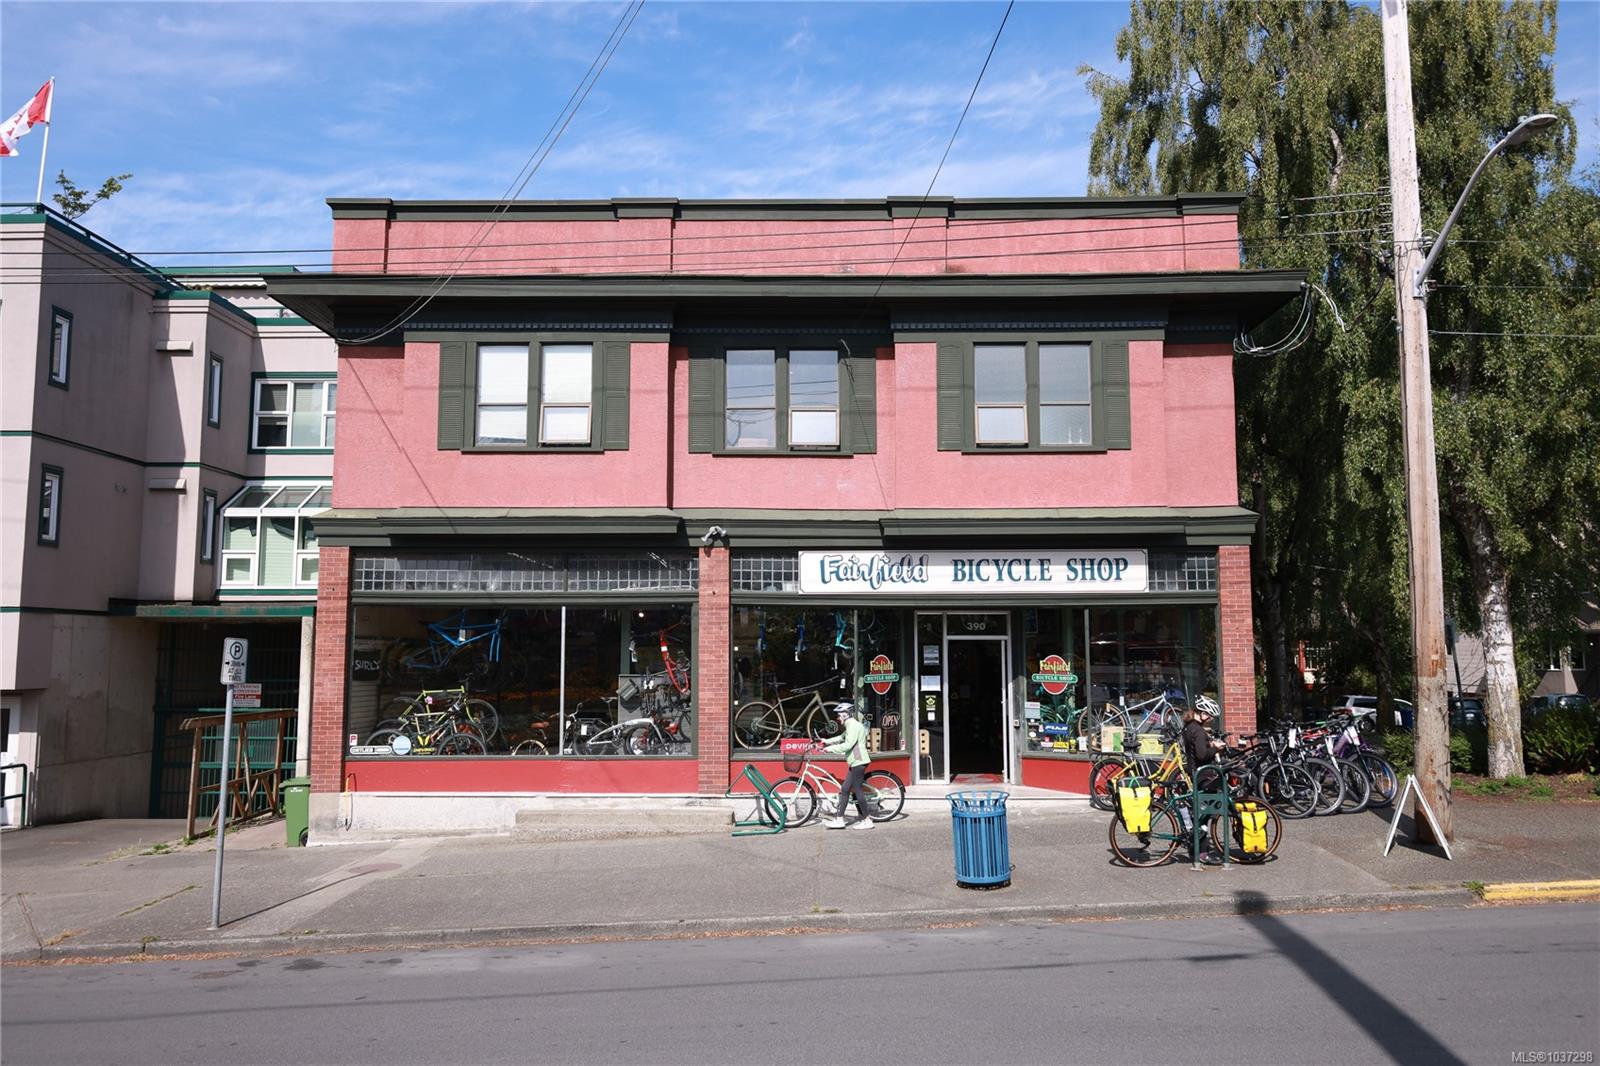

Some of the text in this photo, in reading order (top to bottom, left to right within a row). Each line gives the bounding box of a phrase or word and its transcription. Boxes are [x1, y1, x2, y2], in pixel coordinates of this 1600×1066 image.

[820, 554, 1129, 590] Fairfield BICYCLE SHOP
[967, 622, 986, 630] 390
[234, 645, 241, 656] P
[354, 659, 380, 671] SURLY
[870, 660, 894, 673] Fairfield
[1040, 660, 1070, 674] Fairfield
[882, 714, 898, 726] OPEN
